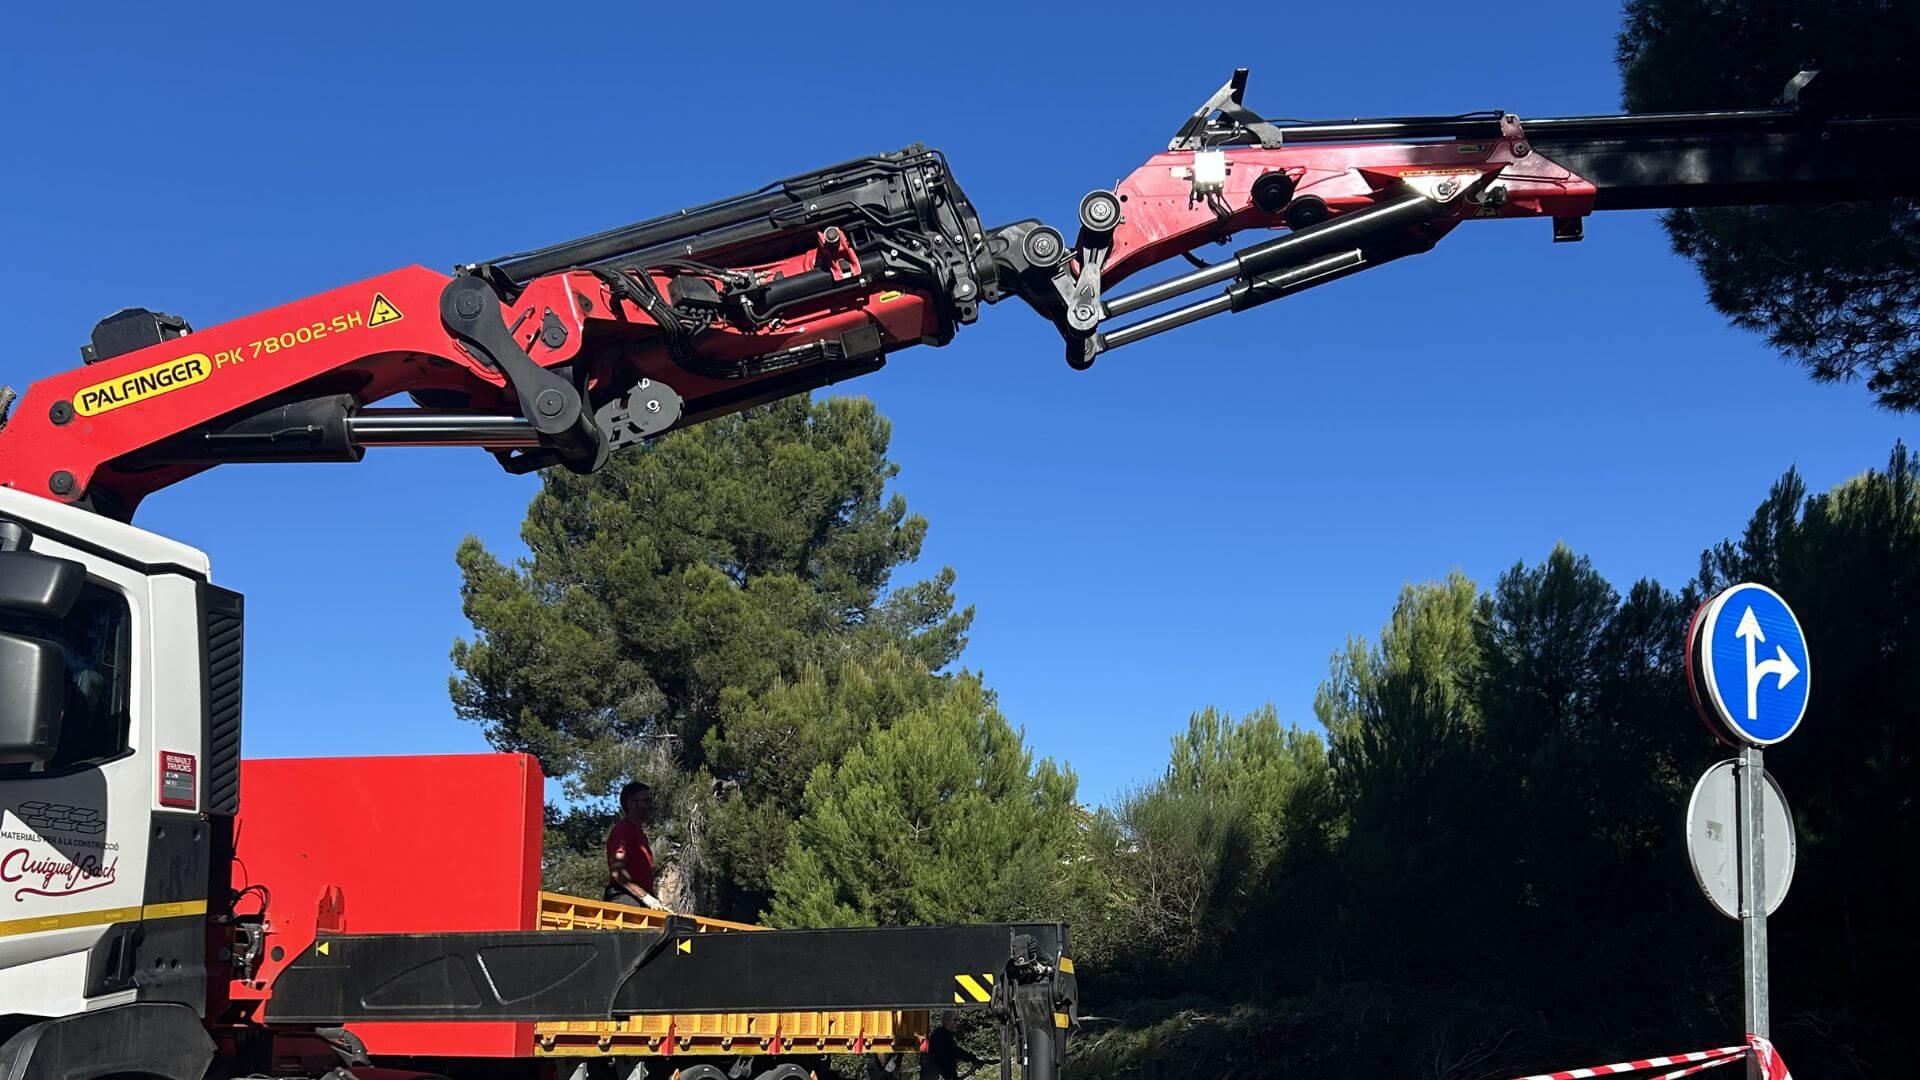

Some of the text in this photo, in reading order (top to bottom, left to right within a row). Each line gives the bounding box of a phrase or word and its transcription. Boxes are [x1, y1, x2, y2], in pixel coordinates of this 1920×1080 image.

[214, 311, 363, 369] PK 78002-SH
[82, 360, 203, 411] PALFINGER
[166, 755, 192, 766] RENAULT
[167, 763, 192, 772] TRUCKS
[0, 831, 41, 843] MATERIALS
[43, 835, 58, 844] PER
[64, 838, 73, 846] LA
[74, 839, 119, 851] CONSTRUCCIÓ
